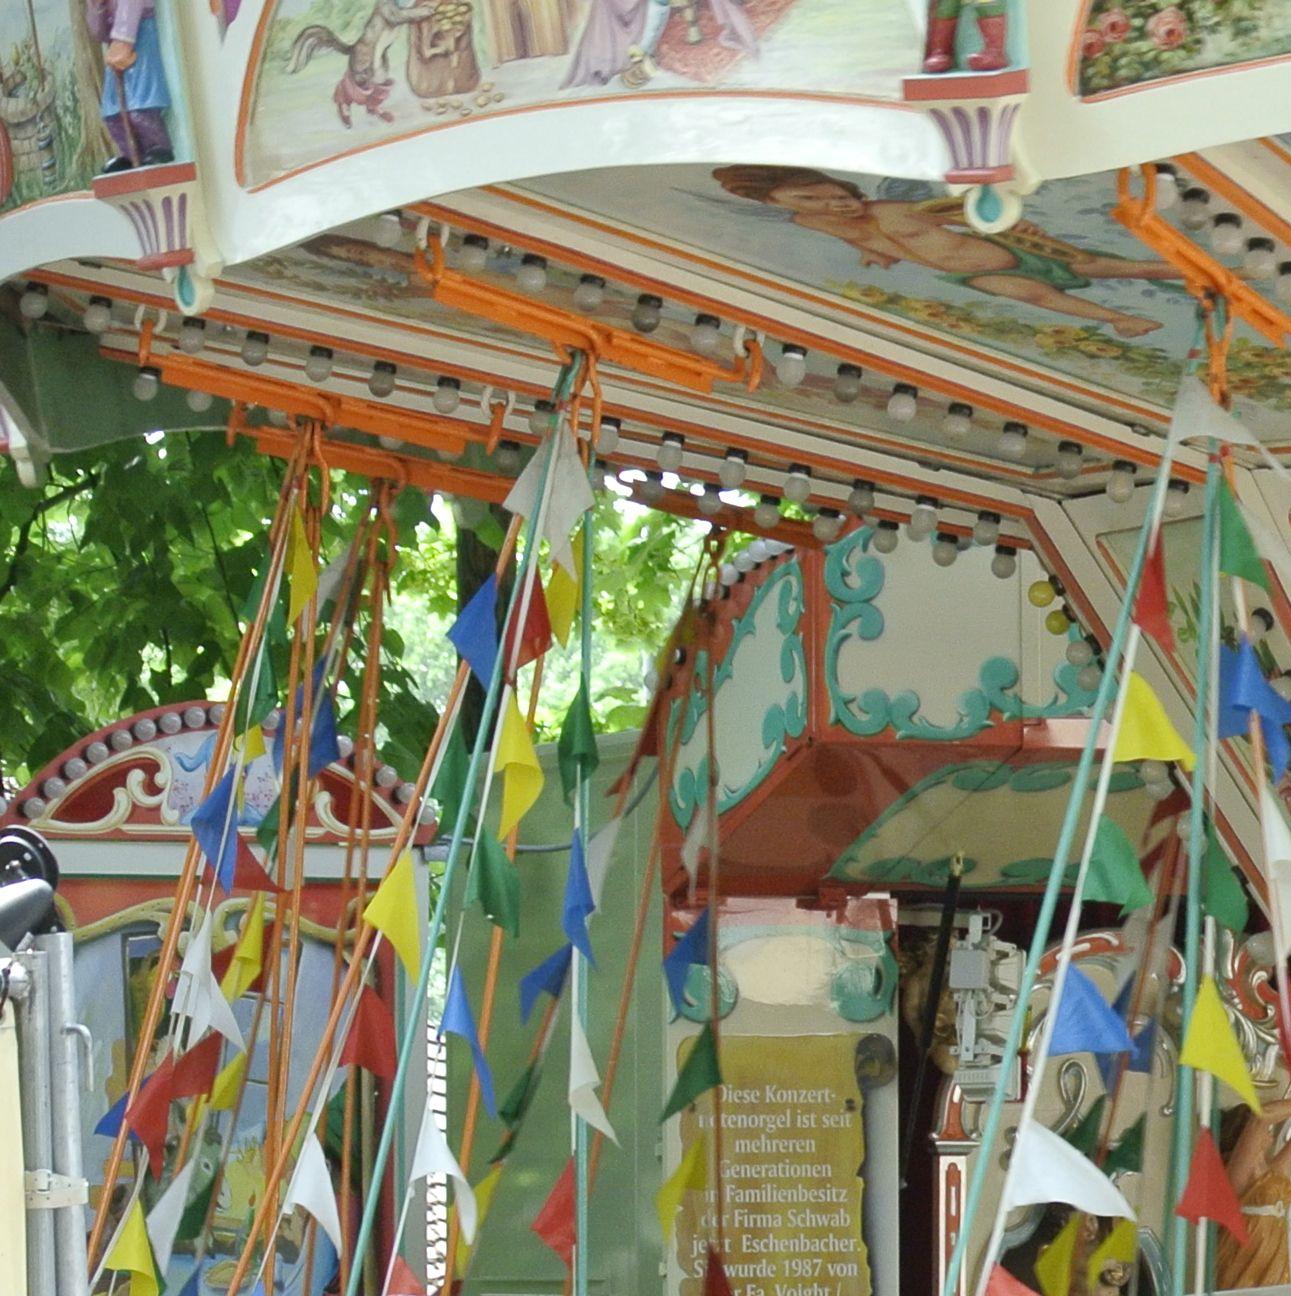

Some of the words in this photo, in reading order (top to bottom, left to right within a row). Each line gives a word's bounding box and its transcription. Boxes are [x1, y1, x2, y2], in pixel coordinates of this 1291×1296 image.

[765, 1085, 836, 1103] Konzert-
[797, 1110, 816, 1128] ist
[822, 1110, 852, 1128] seit
[735, 1134, 816, 1153] mehreren
[719, 1159, 832, 1178] Generationen
[726, 1183, 848, 1203] Familienbesitz
[734, 1208, 782, 1228] Firma
[787, 1208, 851, 1228] Schwab
[742, 1233, 862, 1252] Eschenbacher.
[724, 1258, 776, 1278] wurde
[783, 1258, 823, 1277] 1987
[827, 1263, 858, 1277] von
